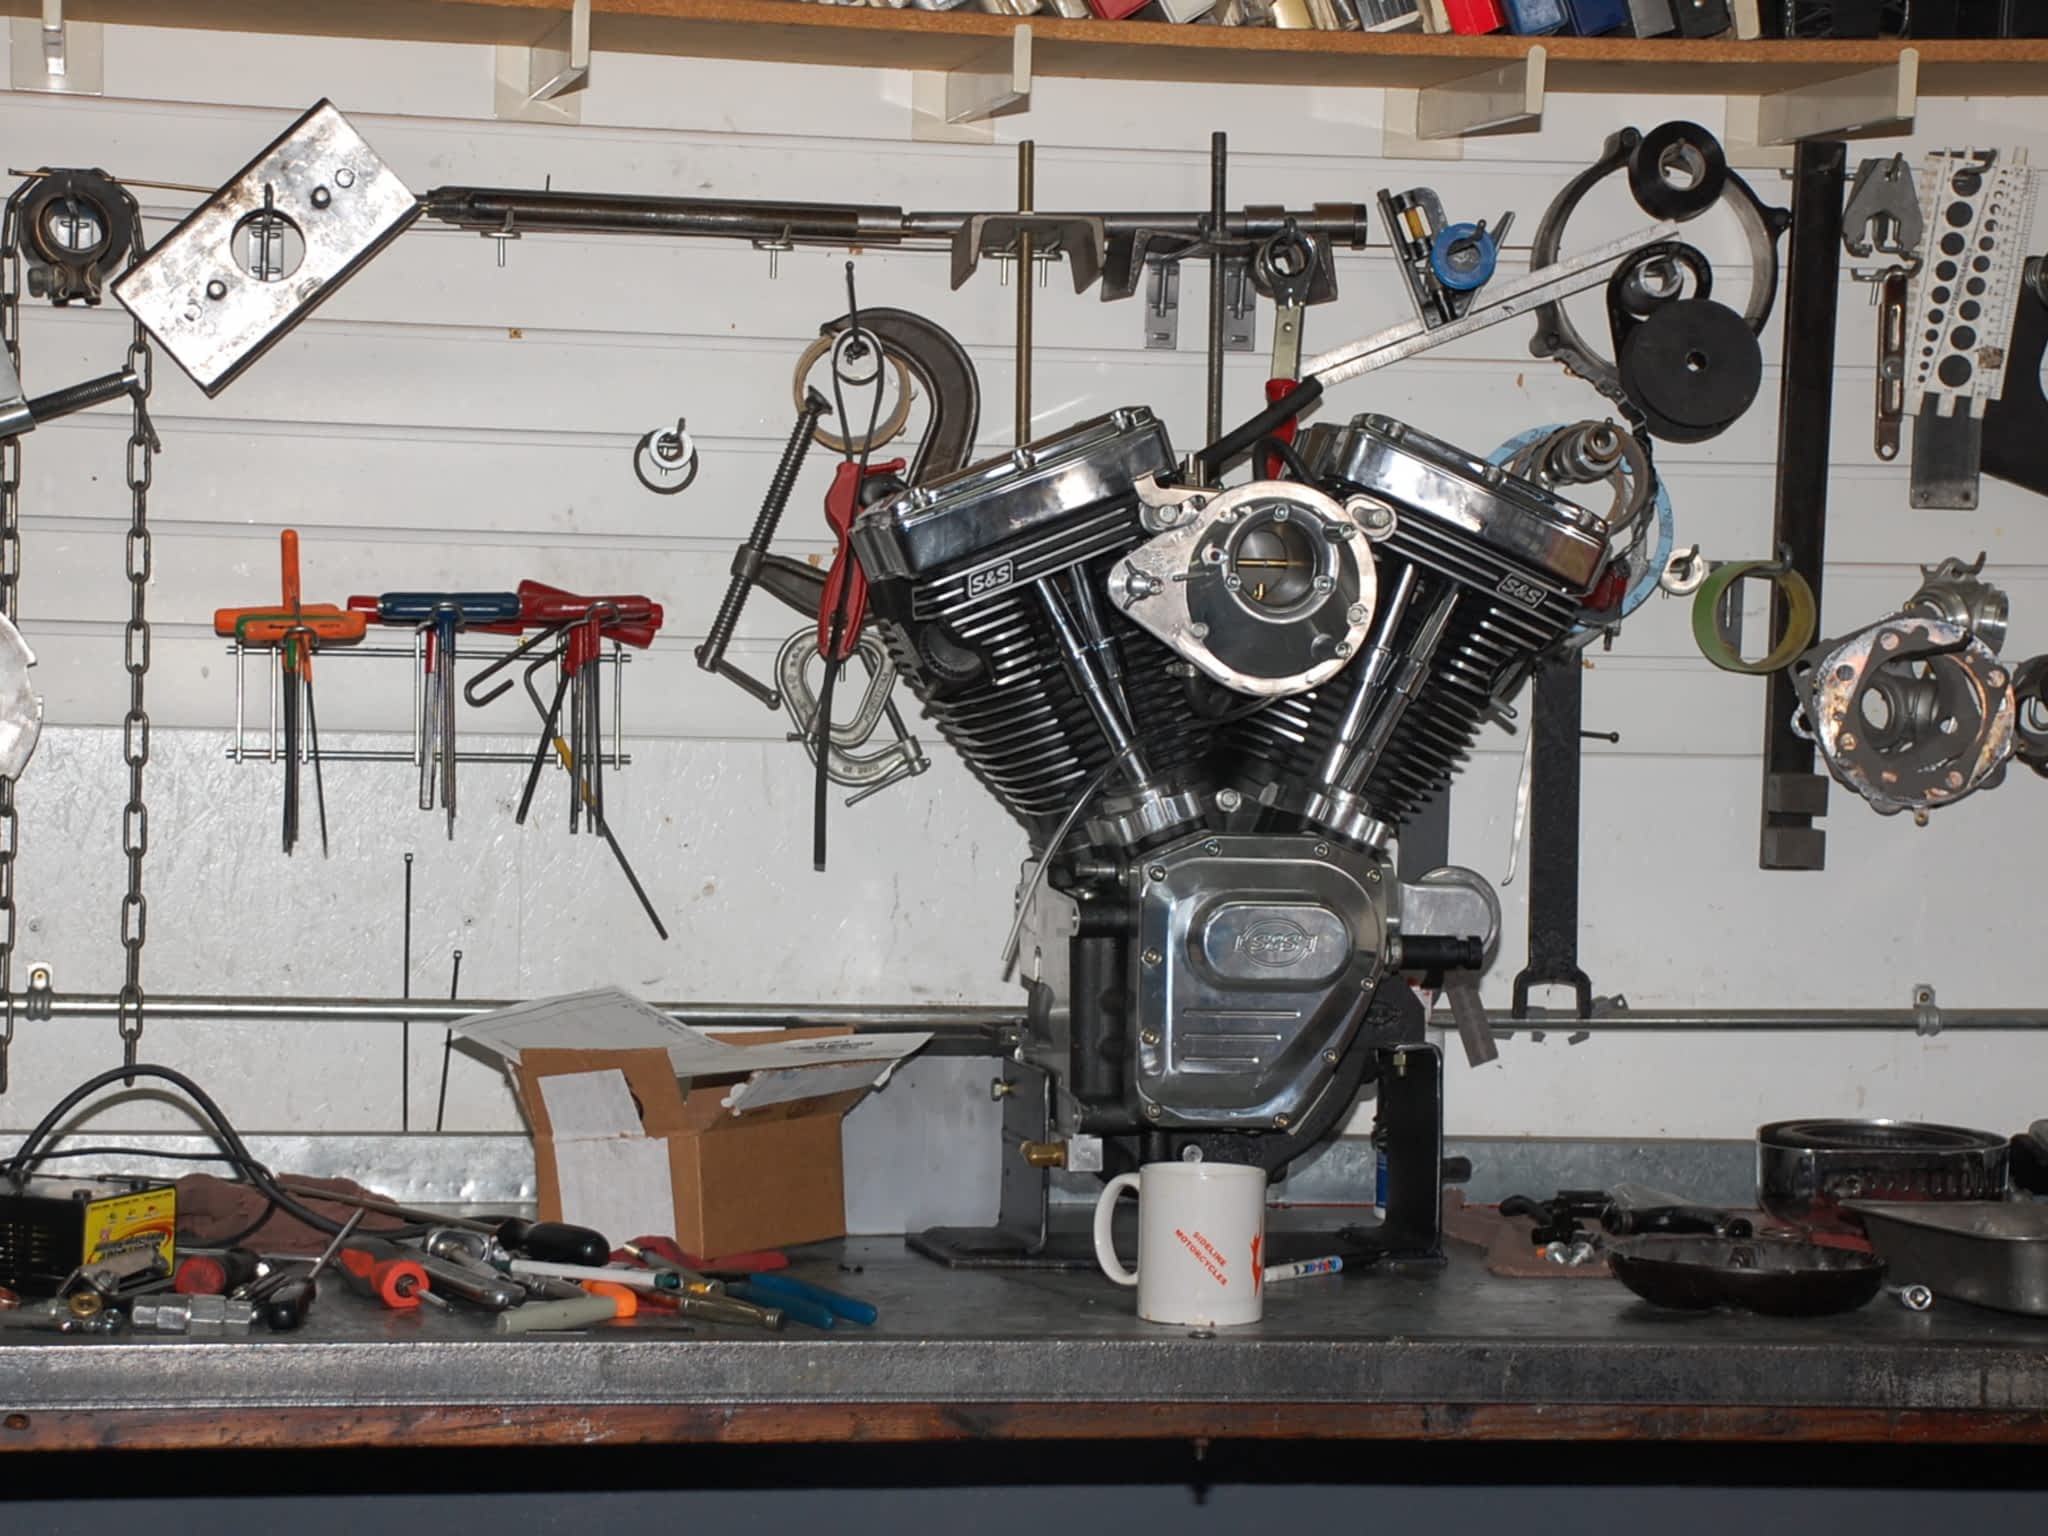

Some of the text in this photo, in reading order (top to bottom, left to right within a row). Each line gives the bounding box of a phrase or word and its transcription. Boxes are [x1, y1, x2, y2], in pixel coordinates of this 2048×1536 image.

[972, 565, 1010, 593] S&S
[1501, 578, 1542, 604] S&S
[1174, 1228, 1229, 1287] MOTORCYCLES
[1192, 1231, 1227, 1268] SIDELINE
